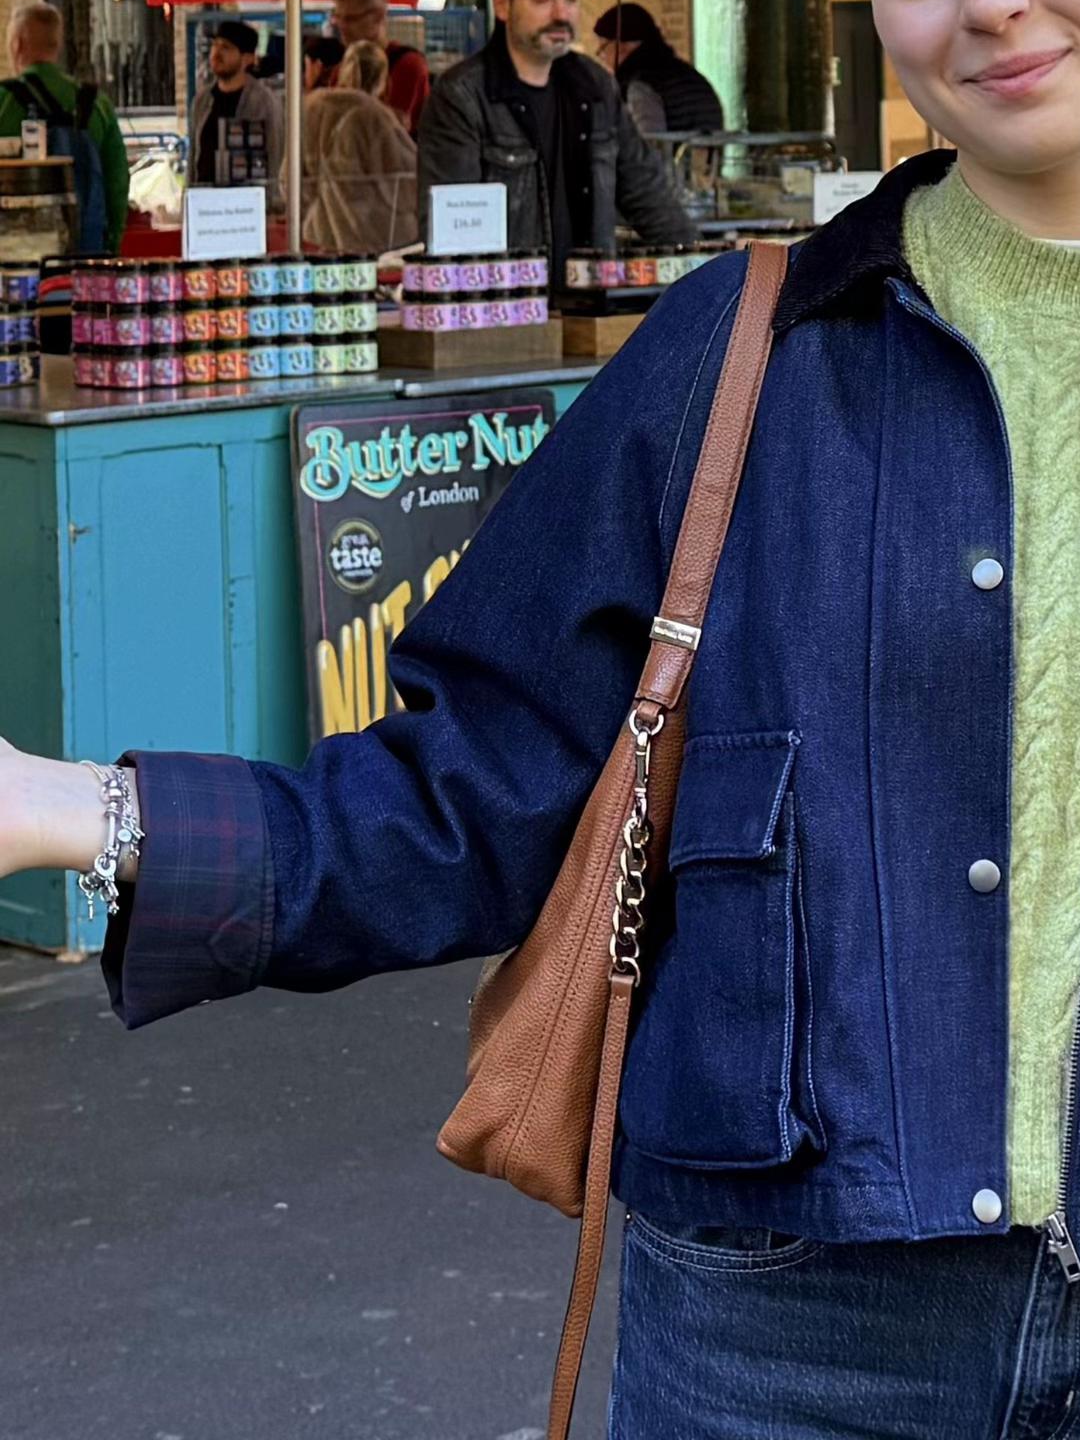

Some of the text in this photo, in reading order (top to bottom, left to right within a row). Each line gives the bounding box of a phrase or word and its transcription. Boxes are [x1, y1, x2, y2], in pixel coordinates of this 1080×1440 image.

[300, 412, 550, 502] Butter Nut
[401, 481, 479, 513] of London
[330, 546, 383, 571] taste
